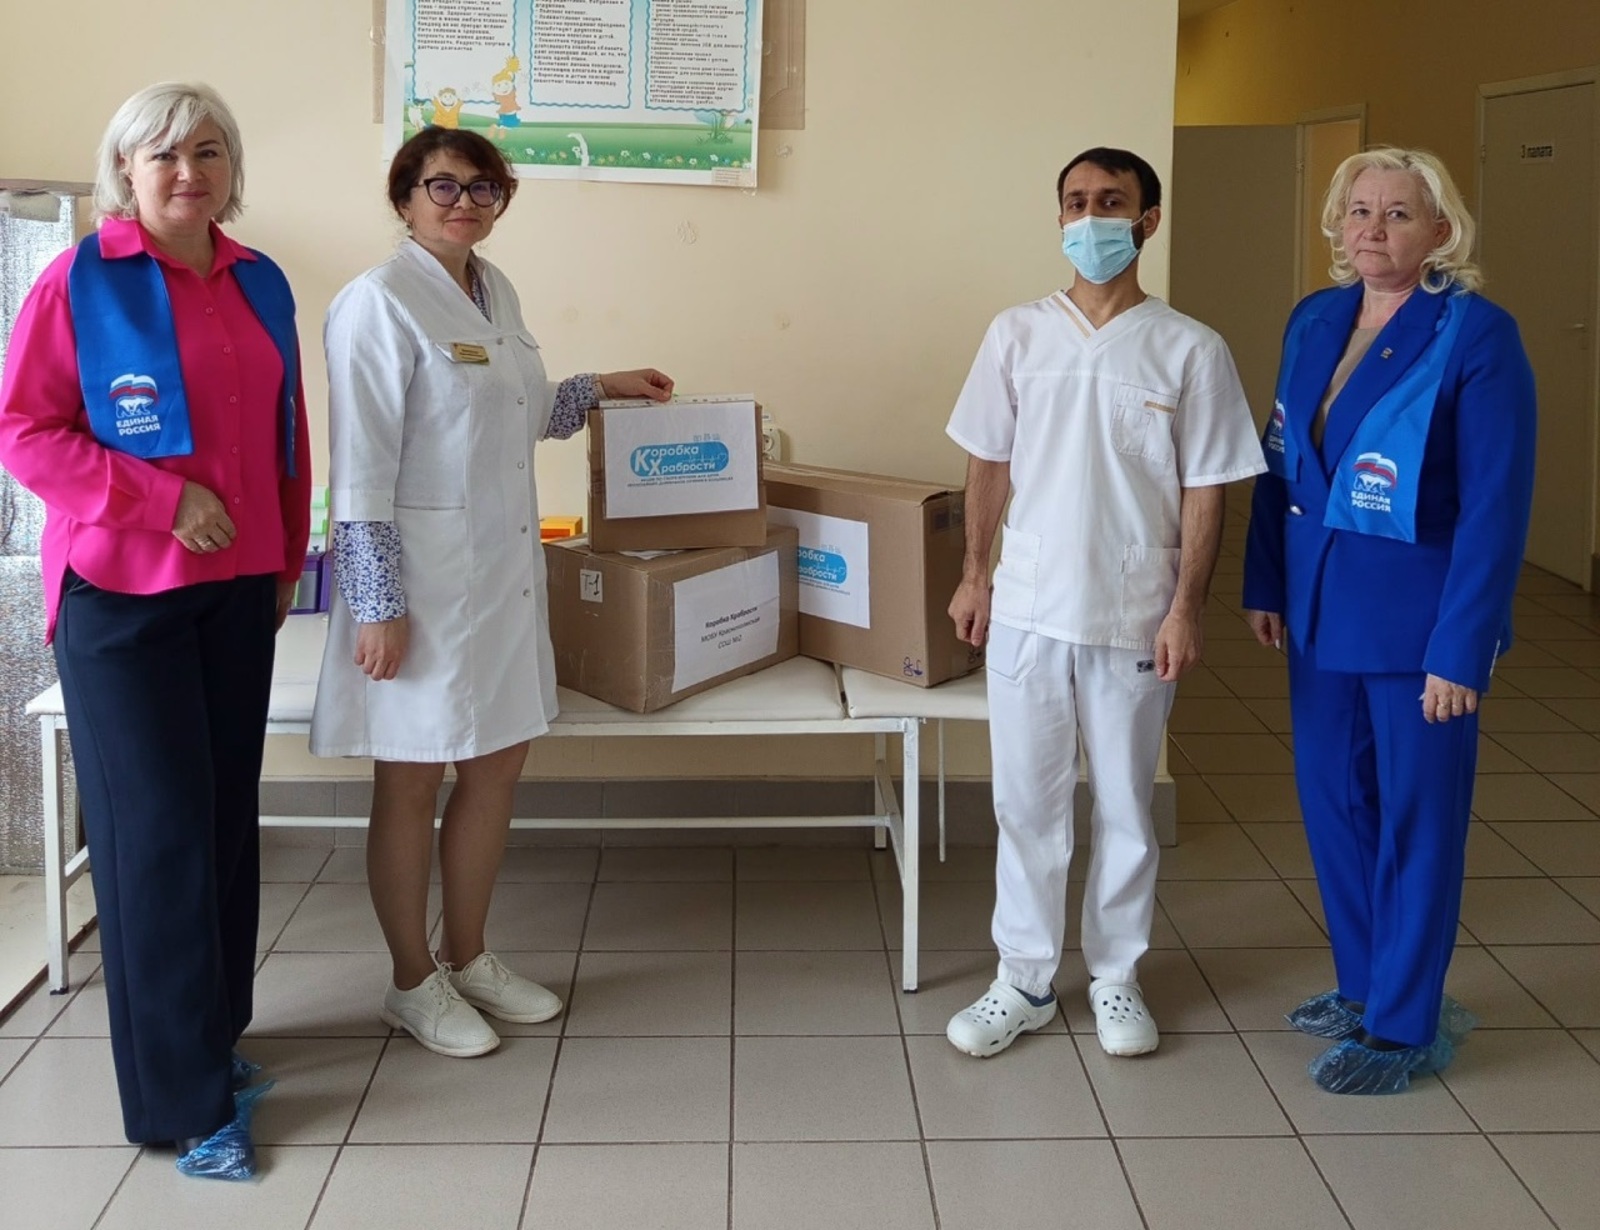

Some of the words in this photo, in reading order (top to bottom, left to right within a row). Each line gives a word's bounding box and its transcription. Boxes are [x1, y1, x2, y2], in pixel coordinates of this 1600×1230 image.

[1527, 145, 1553, 158] палата
[115, 414, 159, 428] ЕДИНАЯ
[118, 423, 162, 436] РОССИЯ
[634, 444, 700, 473] Коробка
[648, 459, 717, 476] Храбрости
[1351, 490, 1391, 505] ЕДИНАЯ
[1351, 499, 1392, 513] РОССИЯ
[705, 616, 730, 628] Коробка
